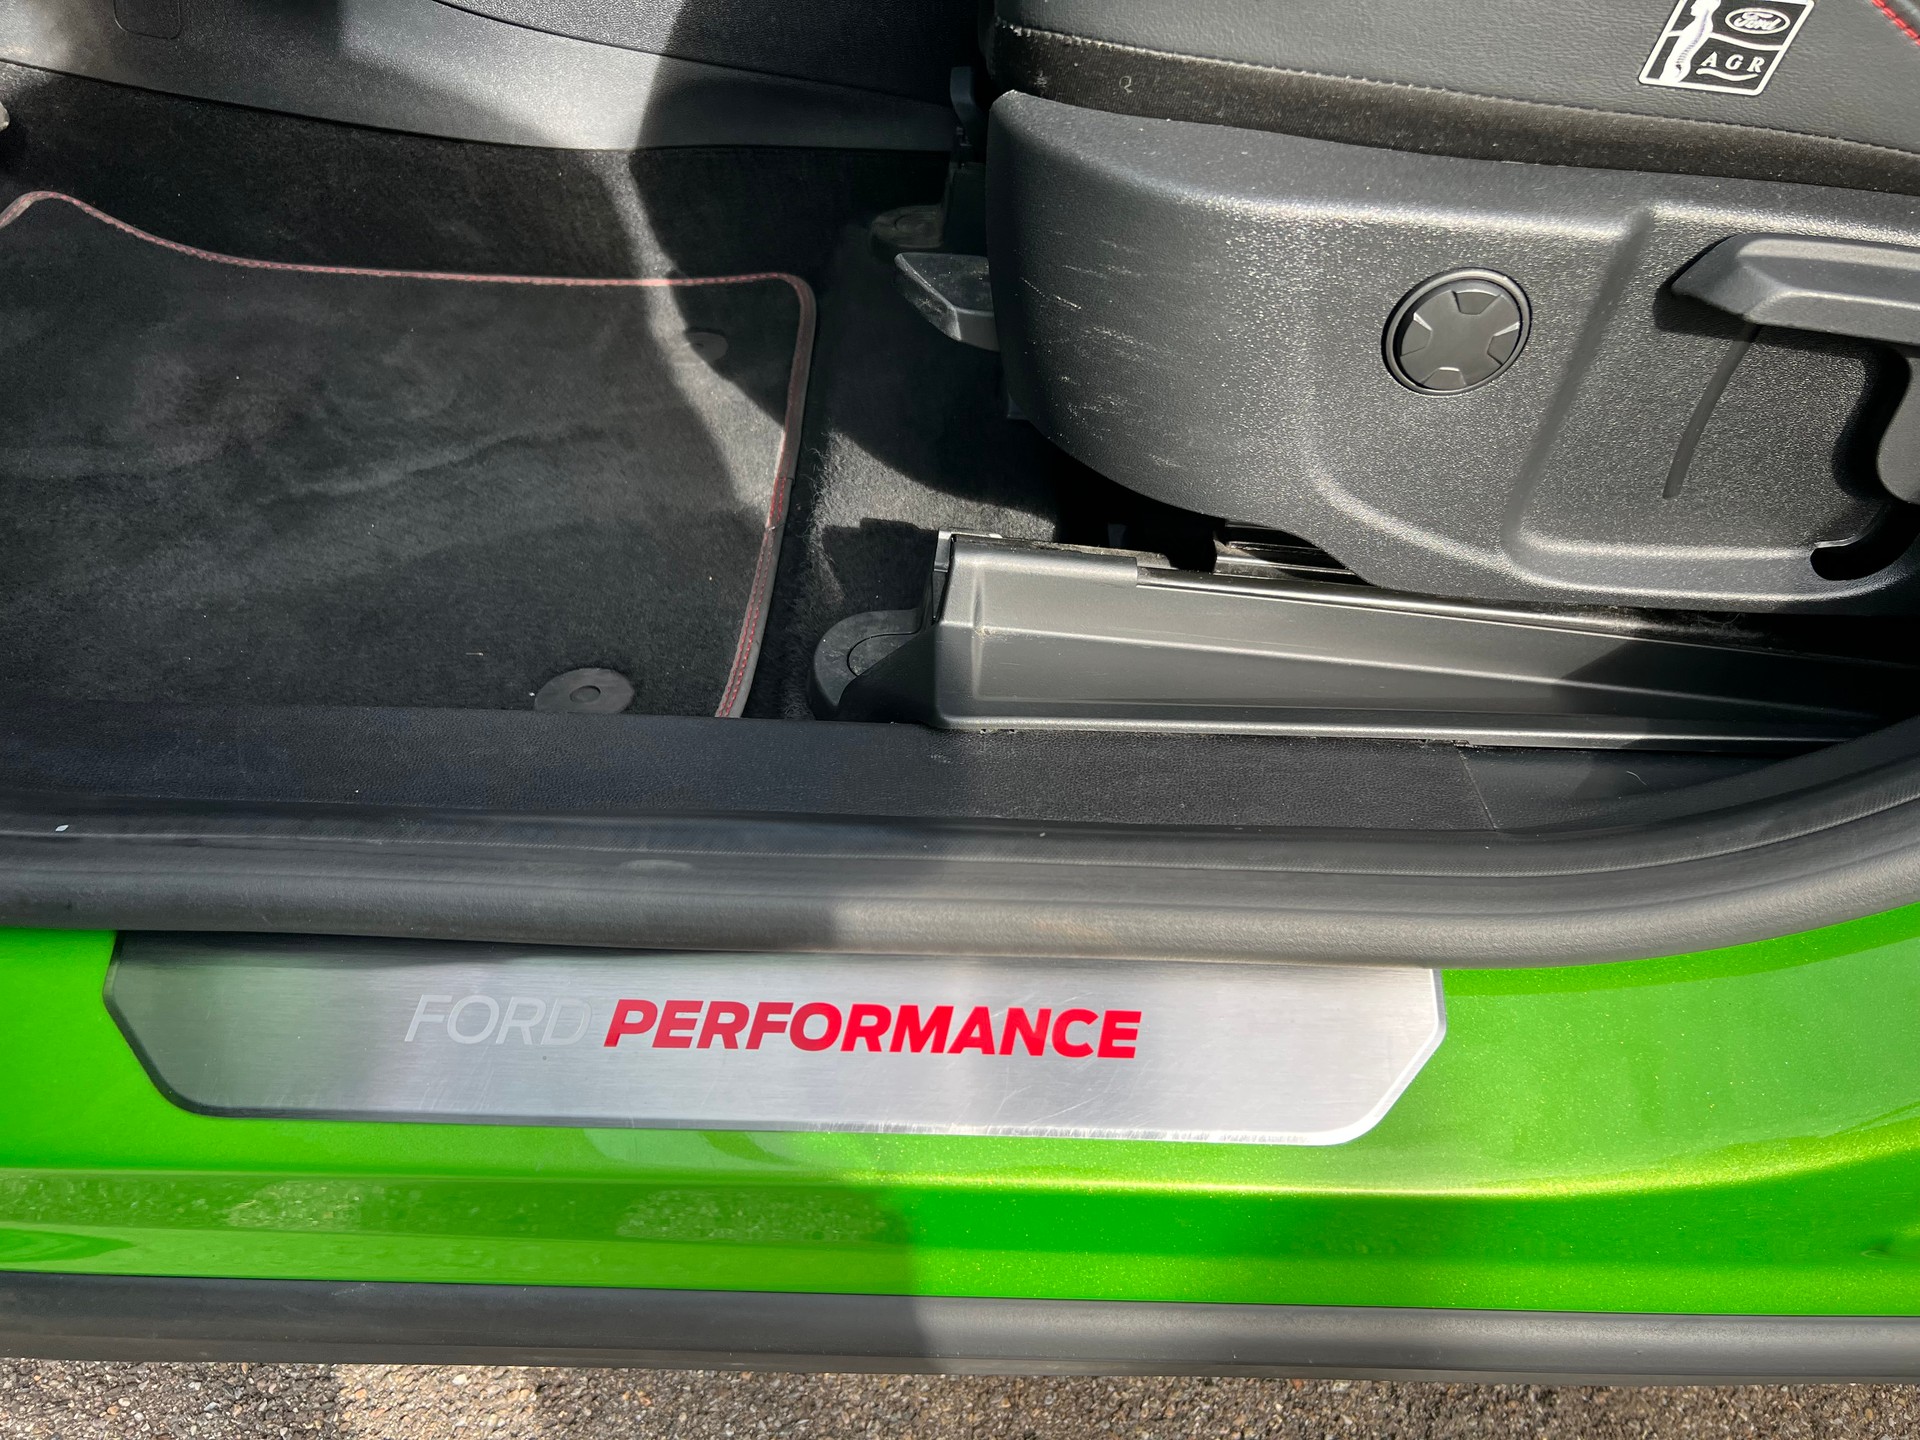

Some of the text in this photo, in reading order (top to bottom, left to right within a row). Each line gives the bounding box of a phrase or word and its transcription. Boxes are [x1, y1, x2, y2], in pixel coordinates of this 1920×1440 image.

[1733, 11, 1782, 31] Ford
[404, 994, 1142, 1059] FORD PERFORMANCE
